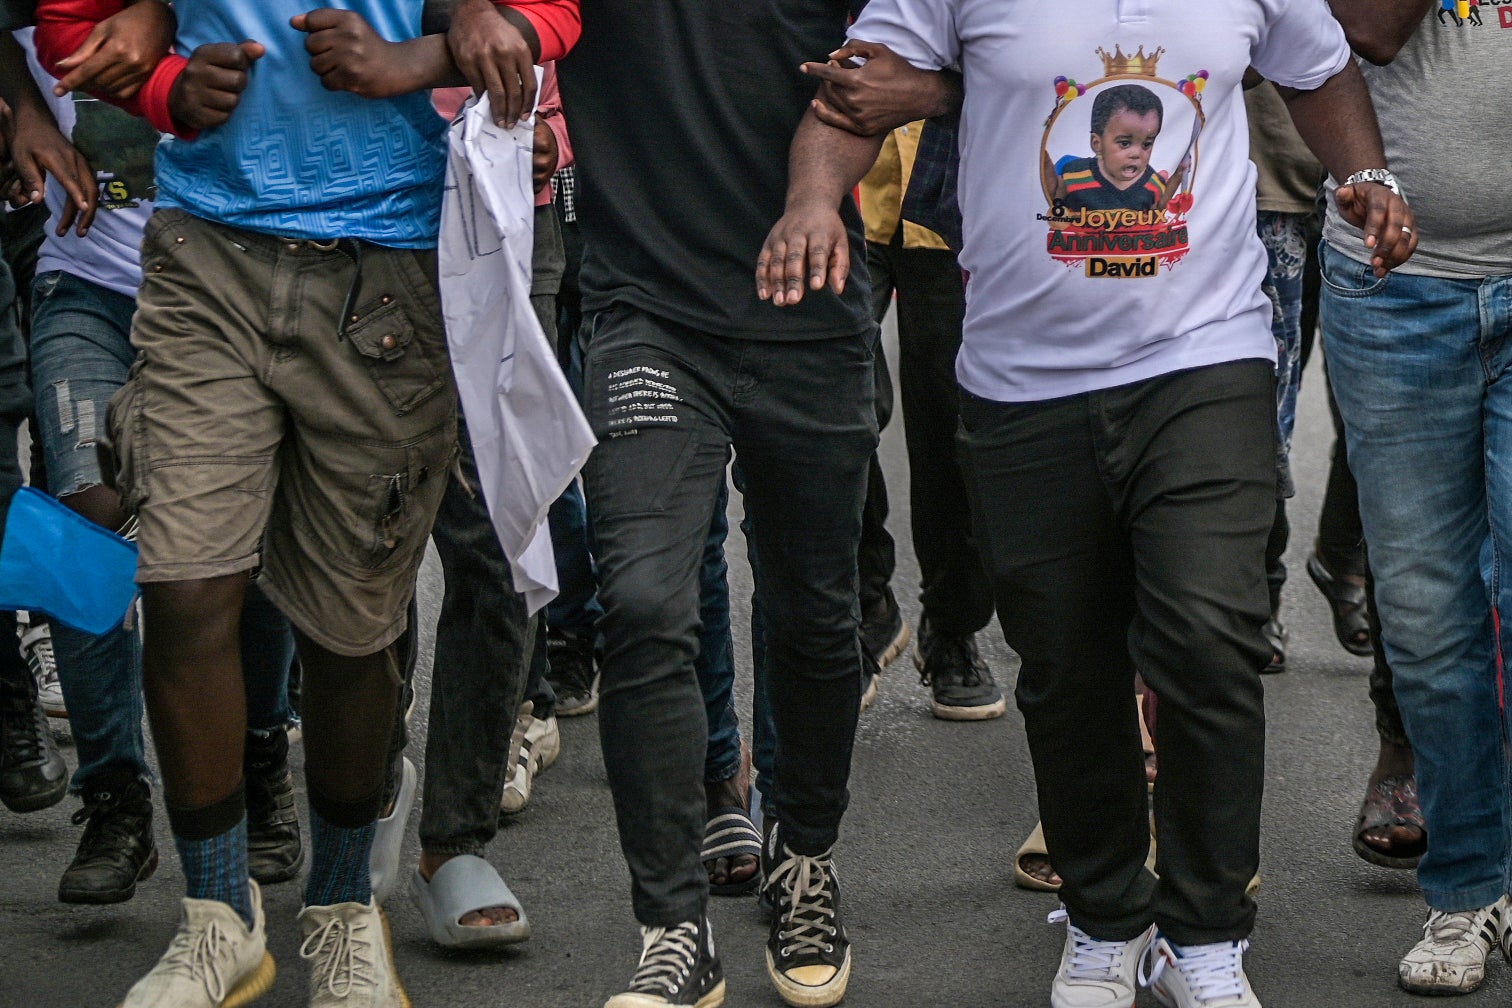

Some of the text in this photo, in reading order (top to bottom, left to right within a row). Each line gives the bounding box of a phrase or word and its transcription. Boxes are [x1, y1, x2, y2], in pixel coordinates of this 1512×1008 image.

[1052, 198, 1065, 217] 8
[1072, 207, 1168, 232] Joyeux
[1050, 225, 1189, 252] Anniversaire
[1089, 258, 1156, 277] David
